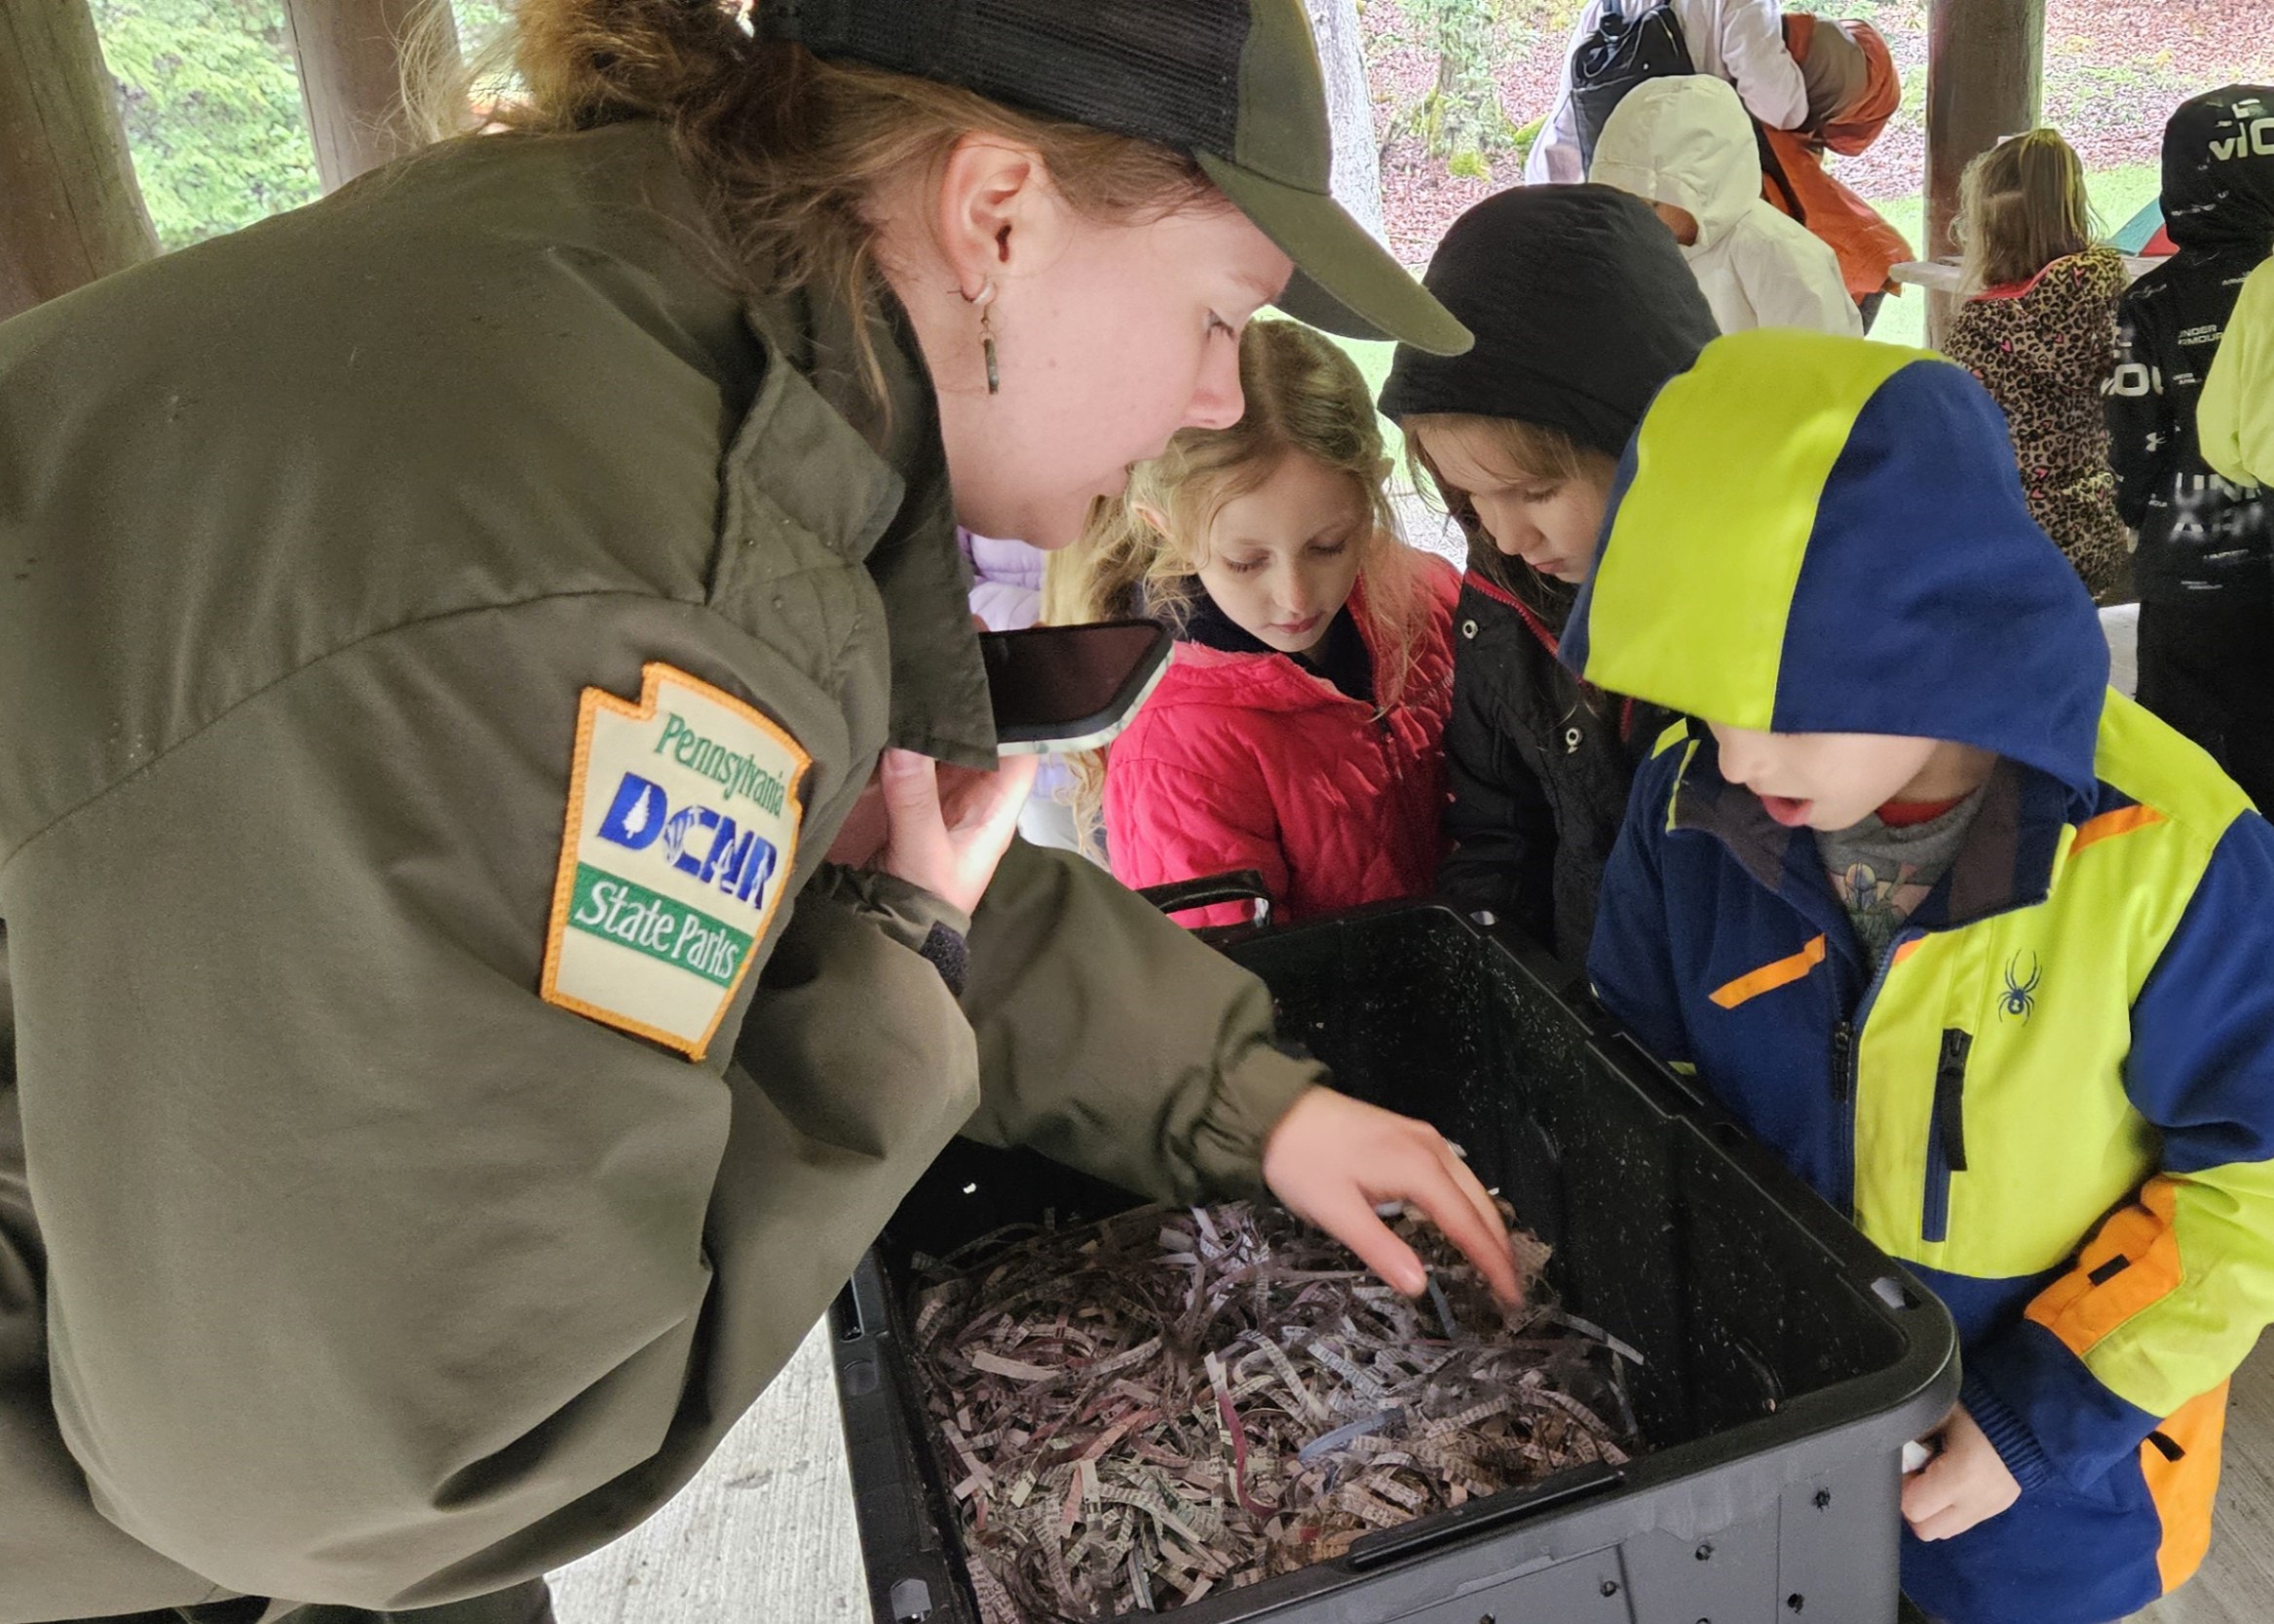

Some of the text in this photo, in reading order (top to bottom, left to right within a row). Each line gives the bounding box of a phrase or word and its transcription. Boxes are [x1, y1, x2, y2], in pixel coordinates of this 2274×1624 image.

[654, 711, 785, 818] Pennsylvania
[597, 771, 778, 911] DCNR
[574, 880, 739, 979] State Parks
